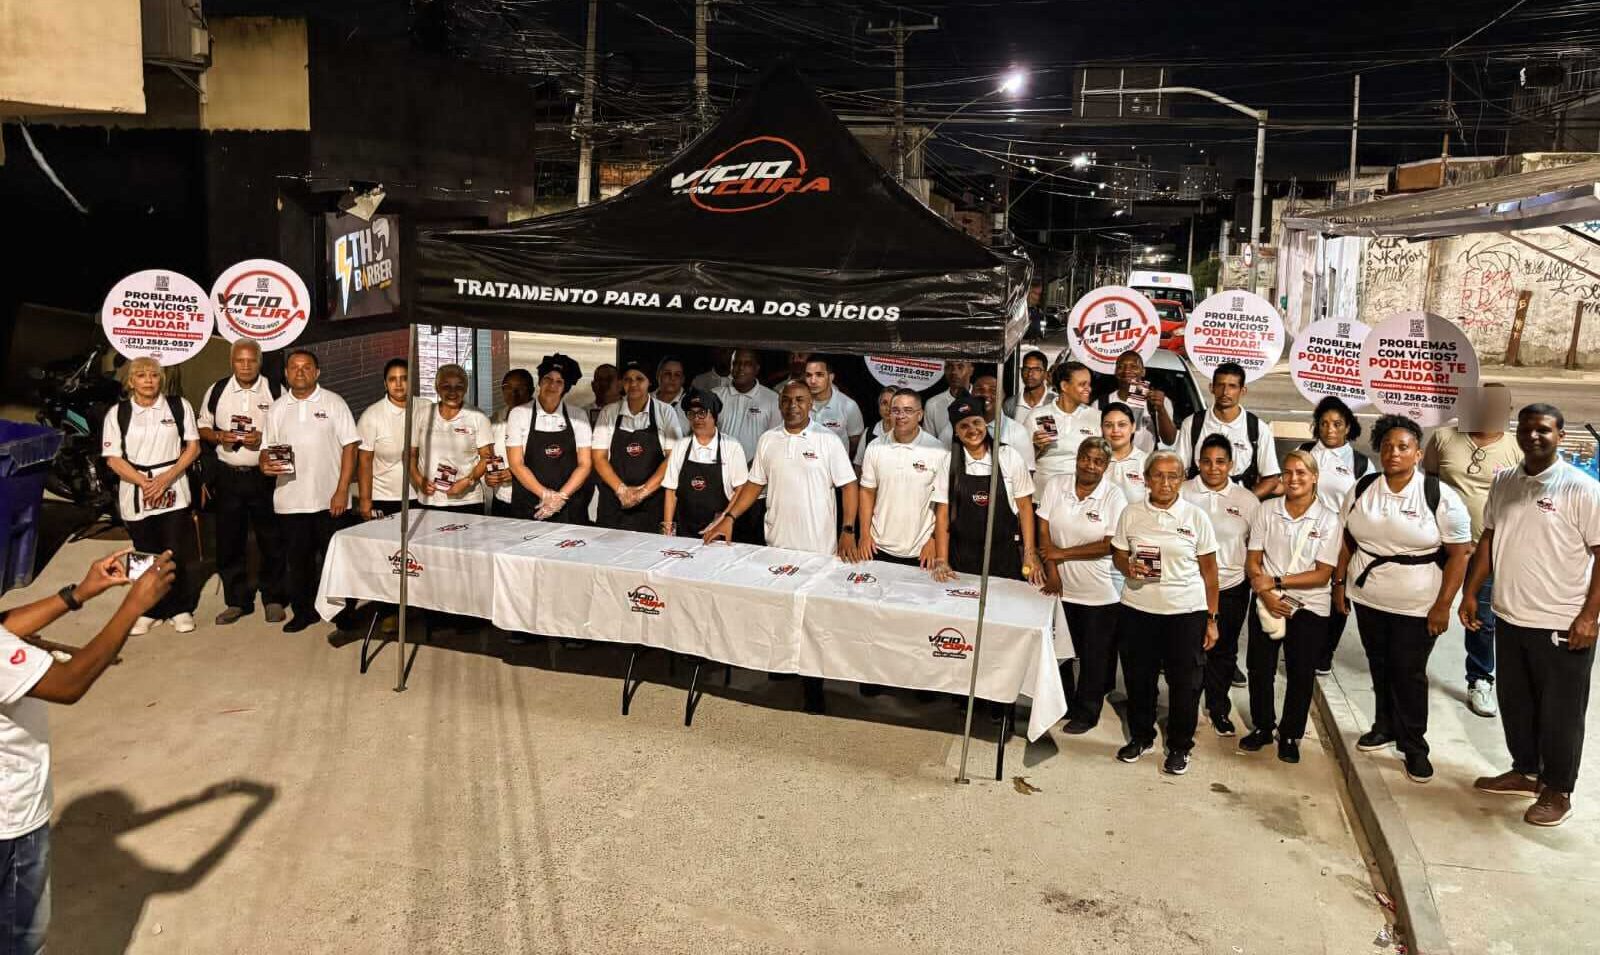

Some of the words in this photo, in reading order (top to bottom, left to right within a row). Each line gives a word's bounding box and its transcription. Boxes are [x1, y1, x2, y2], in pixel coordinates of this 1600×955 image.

[711, 177, 831, 195] CURA
[354, 258, 393, 292] BARBER
[124, 290, 199, 304] PROBLEMAS
[454, 277, 598, 304] TRATAMENTO
[603, 290, 661, 307] PARA
[666, 294, 684, 308] A
[694, 296, 756, 314] CURA
[763, 300, 812, 317] DOS
[819, 300, 902, 321] VÍCIOS
[122, 300, 150, 308] COM
[153, 300, 199, 313] VÍCIOS?
[245, 306, 306, 321] CURA
[112, 307, 185, 321] PODEMOS
[188, 314, 205, 323] TE
[1204, 311, 1270, 323] PROBLEMAS
[127, 318, 190, 331] AJUDAR!
[1202, 320, 1226, 329] COM
[1230, 320, 1270, 332] VÍCIOS?
[1101, 325, 1158, 344] CURA
[1194, 327, 1257, 339] PODEMOS
[1260, 333, 1276, 341] TE
[128, 337, 144, 346] (21)
[1206, 337, 1262, 350] AJUDAR!
[1309, 336, 1361, 350] PROBLEM
[1379, 339, 1457, 351] PROBLEMAS
[1205, 355, 1220, 363] (21)
[1307, 345, 1331, 355] COM
[1334, 348, 1361, 359] VÍCI
[1378, 349, 1405, 359] COM
[1408, 348, 1458, 362] VÍCIOS?
[1311, 363, 1361, 377] AJUDAR
[1369, 357, 1443, 372] PODEMOS
[1447, 363, 1467, 374] TE
[1384, 370, 1450, 384] AJUDAR!
[1310, 383, 1325, 391] (21)
[1326, 385, 1366, 396] 2582-055
[1385, 392, 1401, 401] (21)
[1403, 393, 1457, 405] 2582-0557
